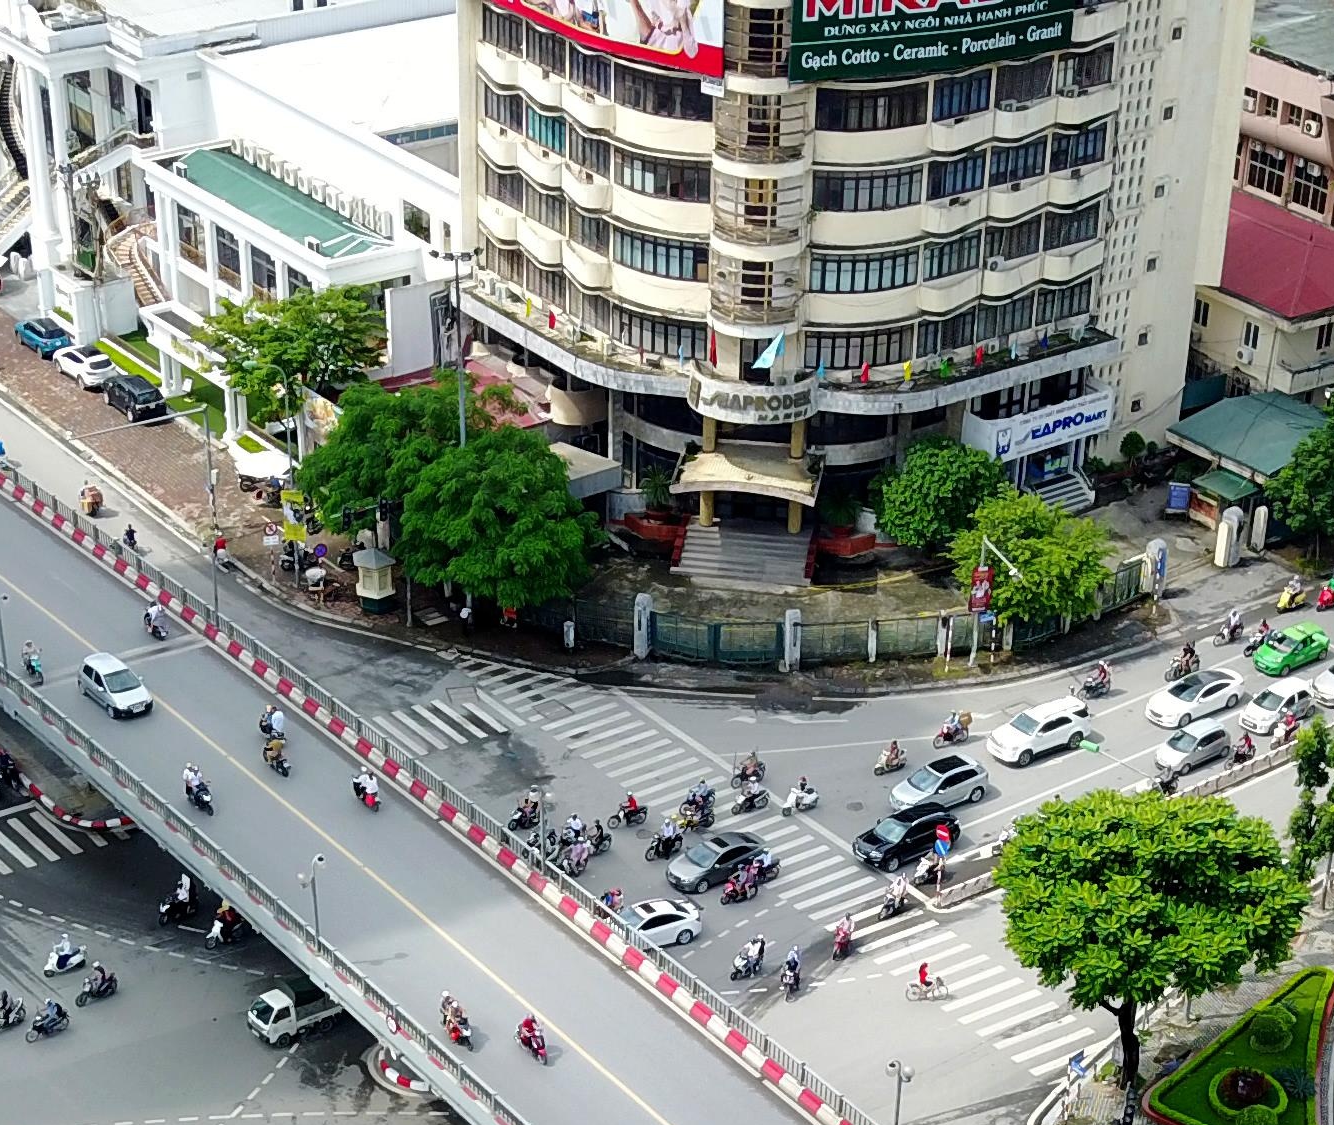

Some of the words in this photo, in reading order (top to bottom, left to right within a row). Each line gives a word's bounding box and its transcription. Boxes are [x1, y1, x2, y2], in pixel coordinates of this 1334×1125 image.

[801, 50, 838, 71] Gạch
[841, 48, 880, 65] Cotto
[893, 41, 949, 60] Ceramic
[961, 31, 1016, 54] Porcelain
[1027, 21, 1063, 42] Granit
